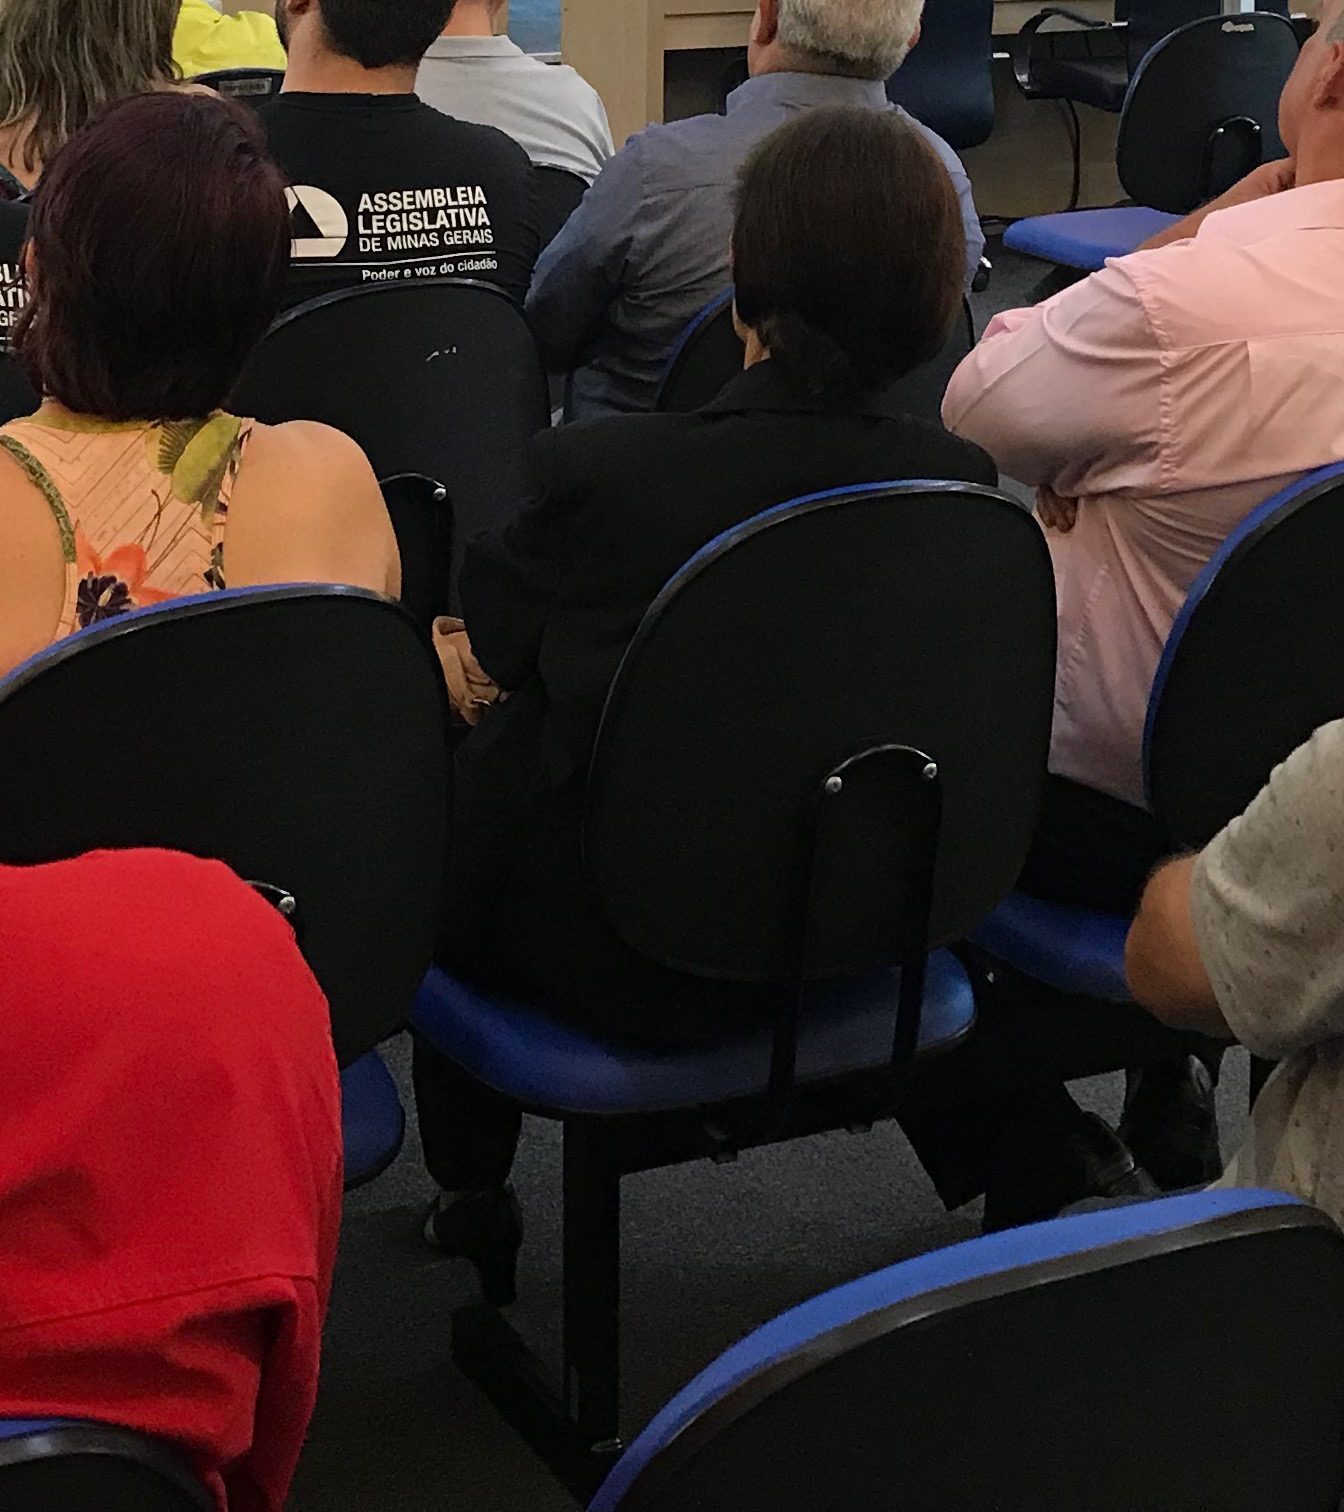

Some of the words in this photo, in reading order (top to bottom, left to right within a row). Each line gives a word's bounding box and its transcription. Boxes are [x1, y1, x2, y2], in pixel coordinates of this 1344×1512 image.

[358, 185, 488, 213] ASSEMBLEIA
[357, 206, 491, 235] LEGISLATIVA
[359, 237, 382, 252] DE
[387, 232, 440, 251] MINAS
[443, 228, 494, 245] GERAIS
[362, 268, 400, 281] Poder
[403, 268, 412, 278] e
[414, 265, 437, 277] voz
[439, 261, 455, 275] do
[457, 257, 498, 272] cidadão
